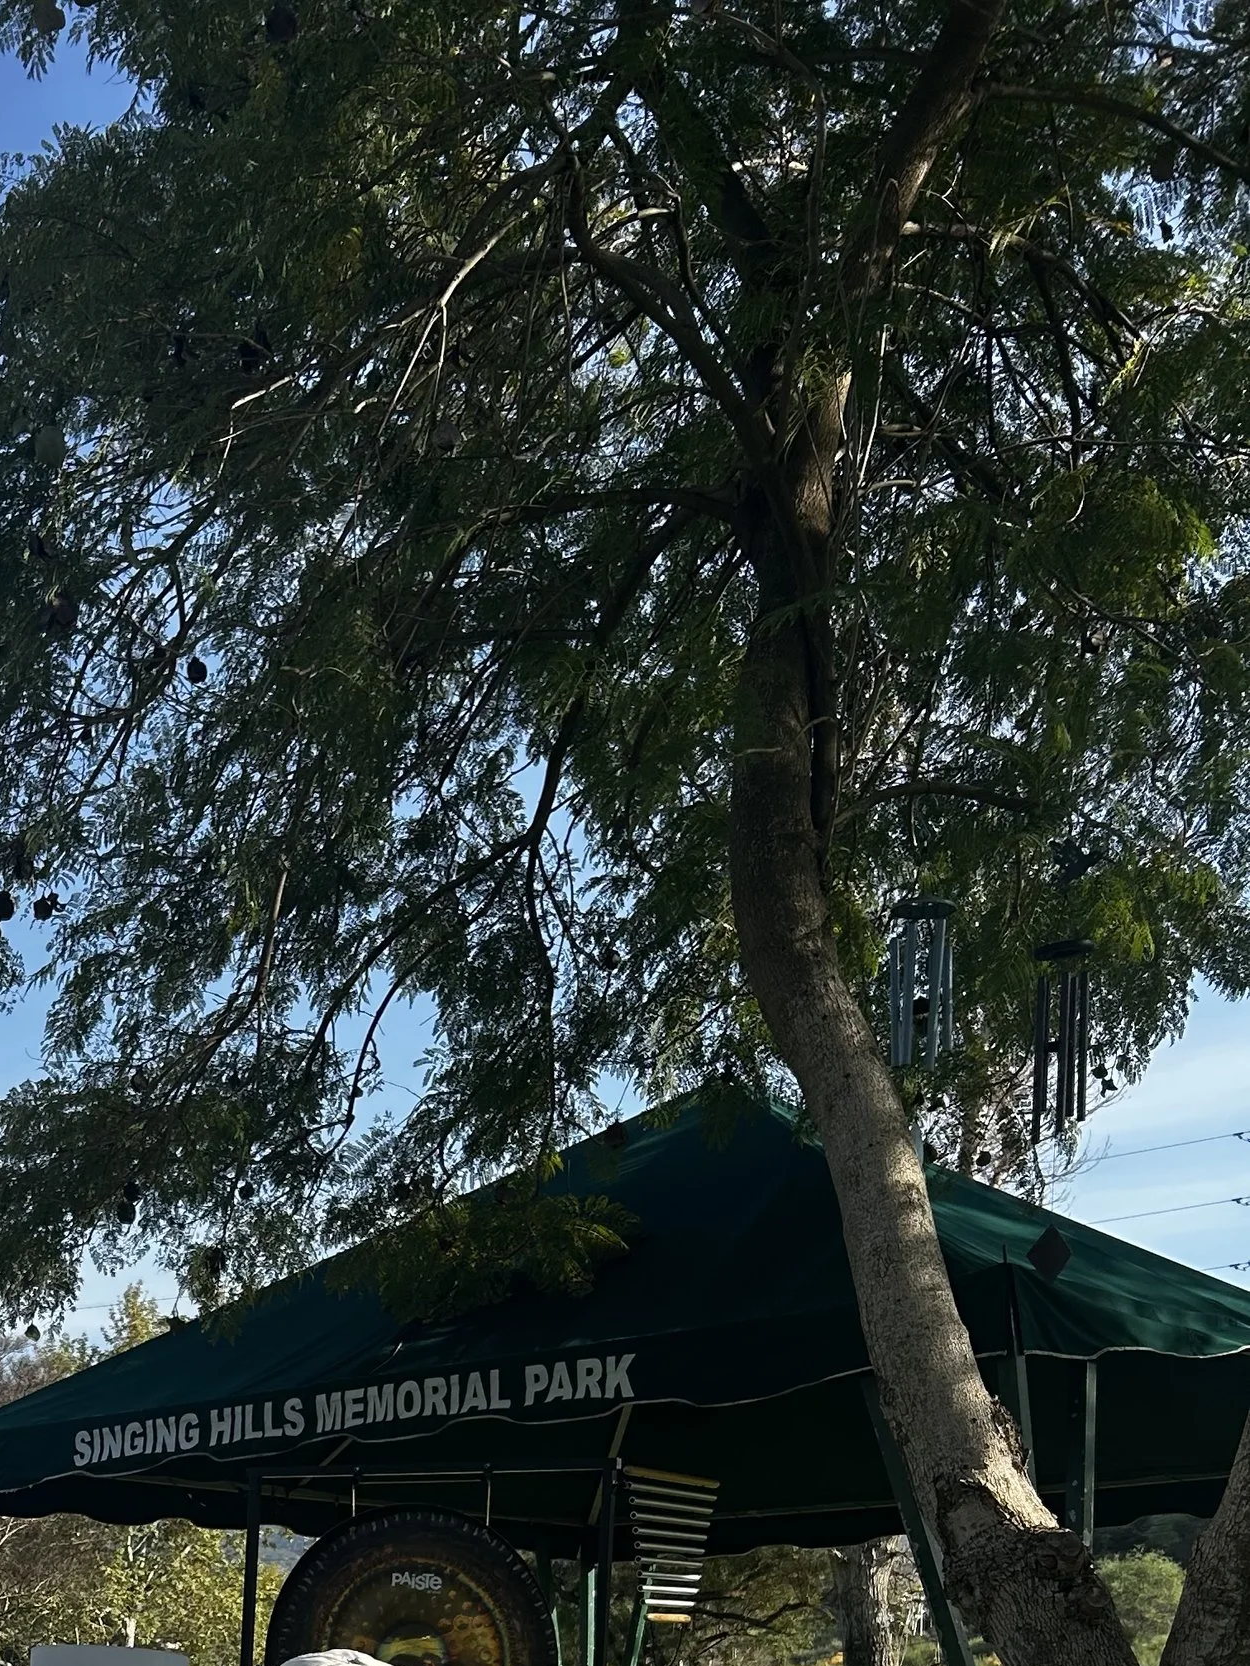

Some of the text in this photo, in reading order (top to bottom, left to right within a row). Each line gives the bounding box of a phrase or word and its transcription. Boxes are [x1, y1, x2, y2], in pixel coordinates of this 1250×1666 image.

[73, 1354, 637, 1467] SINGING HILLS MEMORIAL PARK
